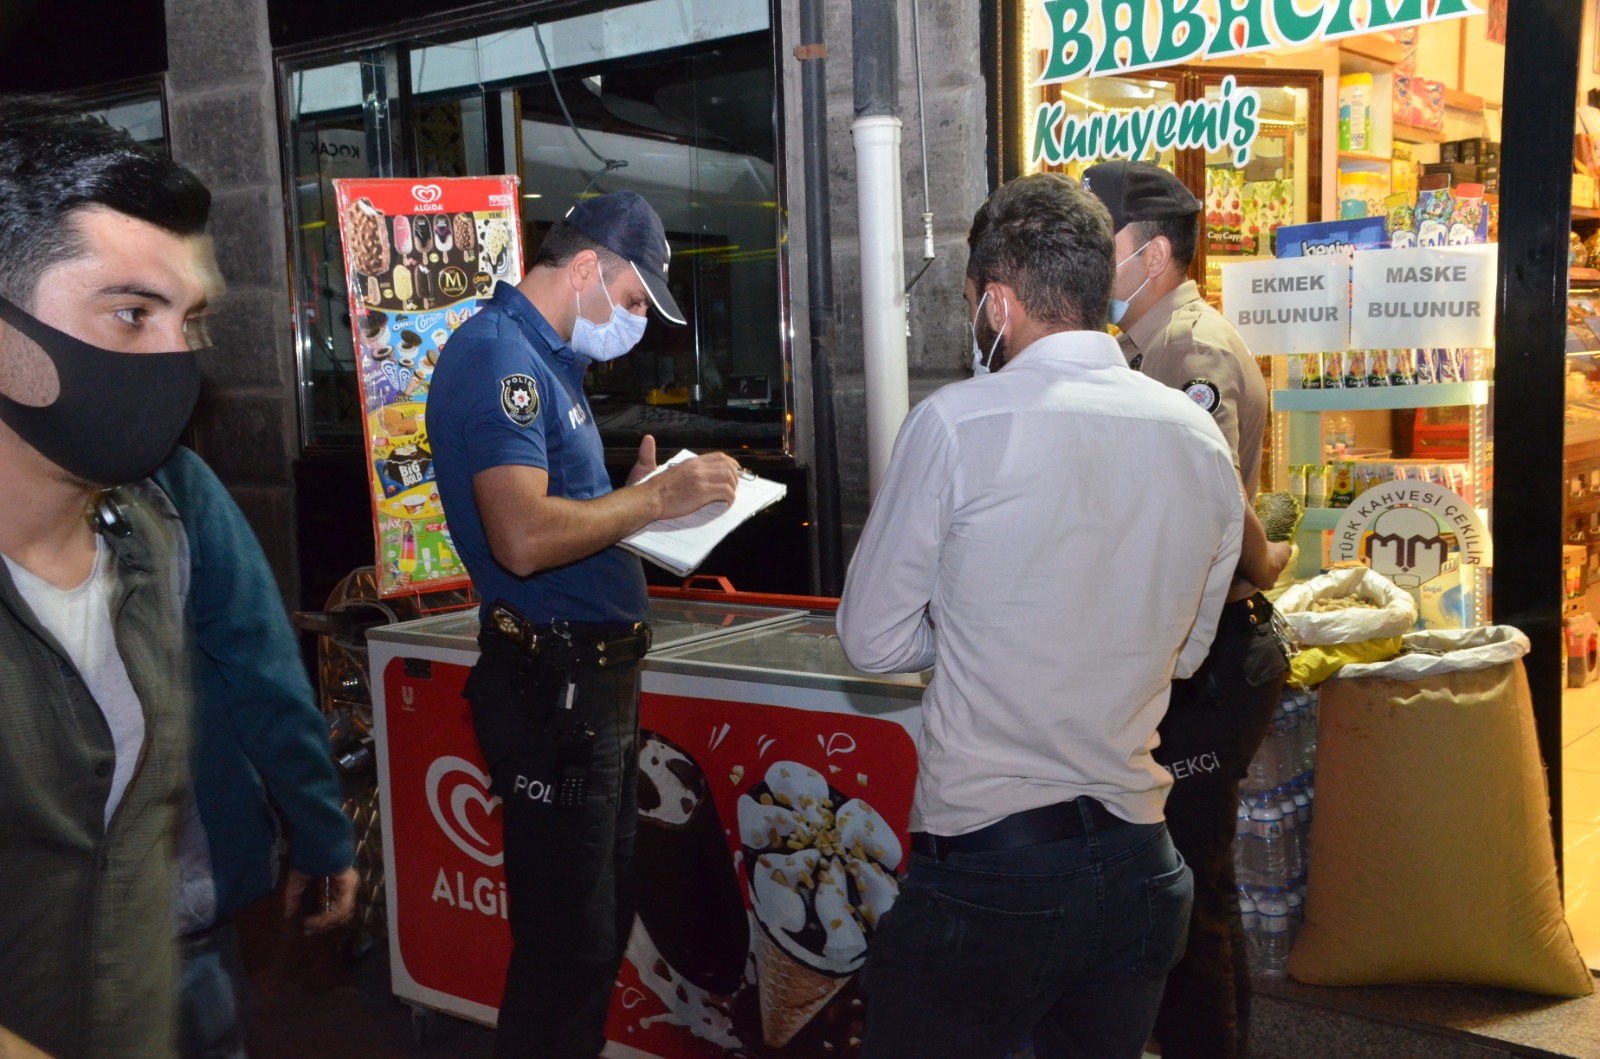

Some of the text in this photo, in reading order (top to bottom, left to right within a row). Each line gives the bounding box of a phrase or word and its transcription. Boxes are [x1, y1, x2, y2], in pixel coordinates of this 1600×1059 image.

[1030, 75, 1261, 168] Kuruyemiş
[1251, 273, 1325, 294] EKMEK
[1385, 265, 1467, 285] MASKE
[1238, 305, 1339, 326] BULUNUR
[1367, 299, 1481, 320] BULUNUR
[402, 471, 423, 487] BOLD
[1338, 490, 1484, 566] TÜRK KAHVESİ ÇEKİLİR
